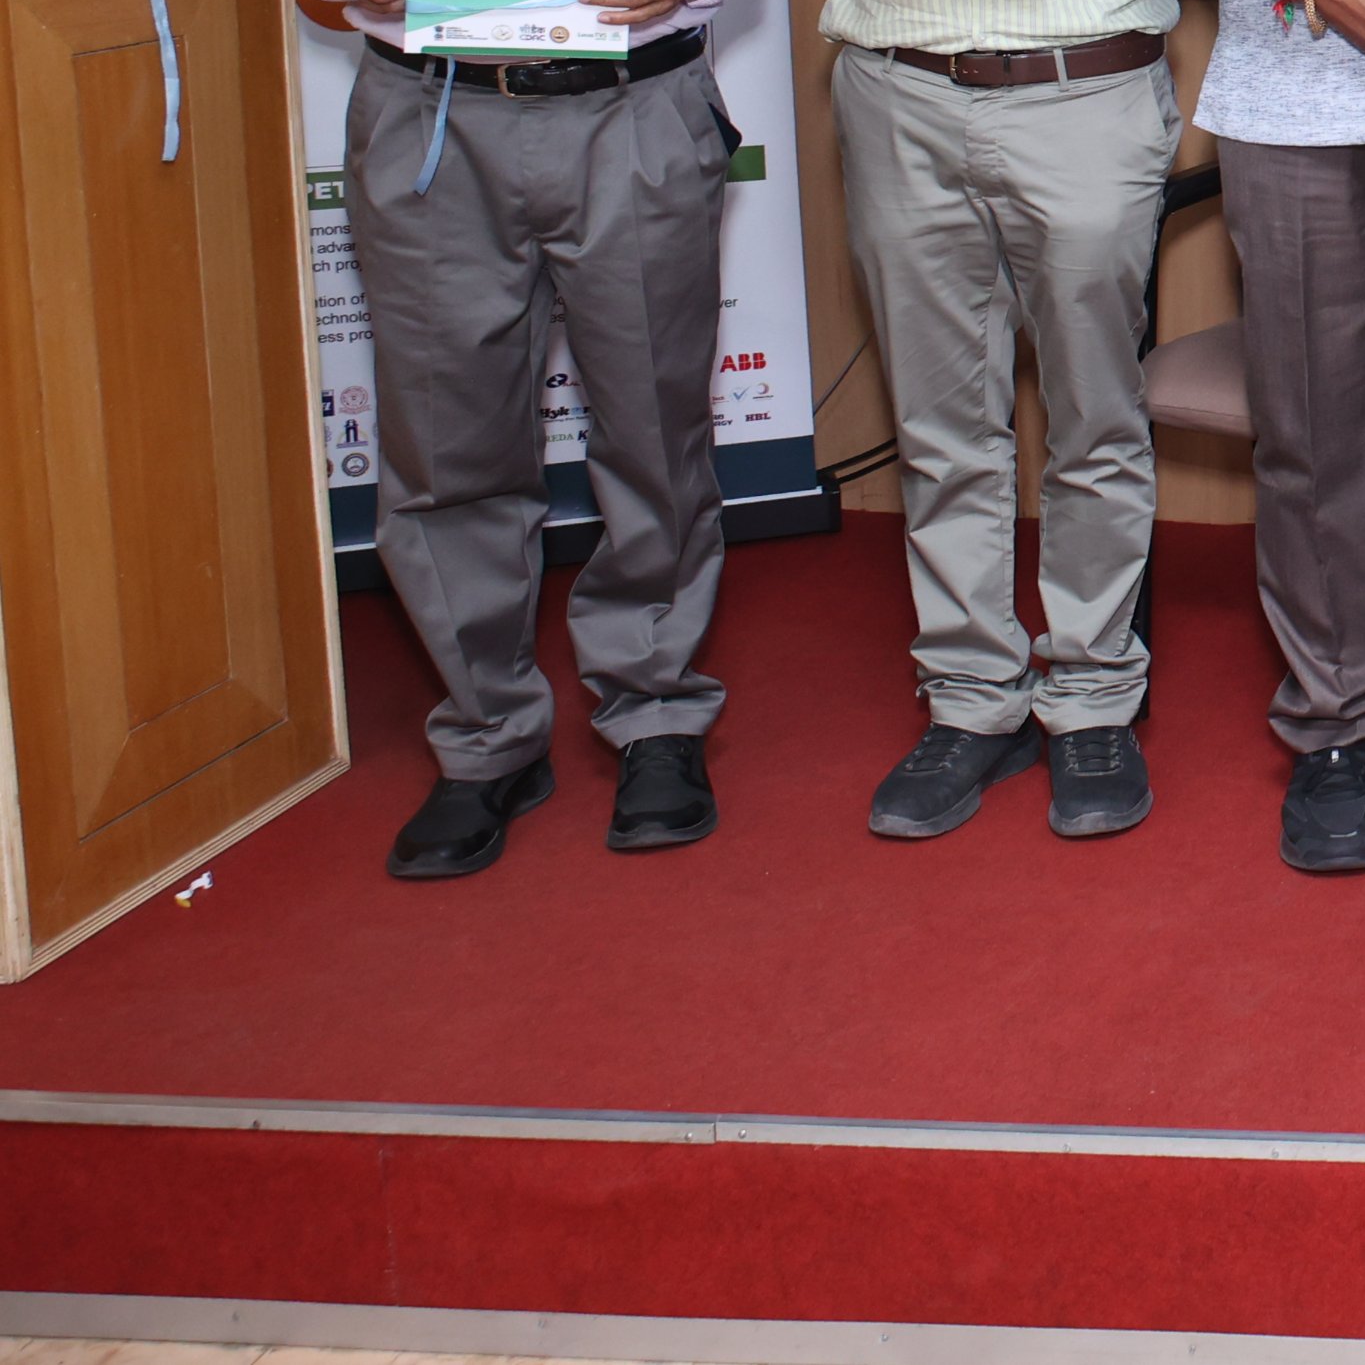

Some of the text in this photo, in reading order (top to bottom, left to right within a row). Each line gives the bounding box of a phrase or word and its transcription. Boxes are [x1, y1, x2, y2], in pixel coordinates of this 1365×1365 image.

[350, 290, 366, 307] of
[720, 352, 767, 373] ABB
[745, 412, 771, 422] HBL
